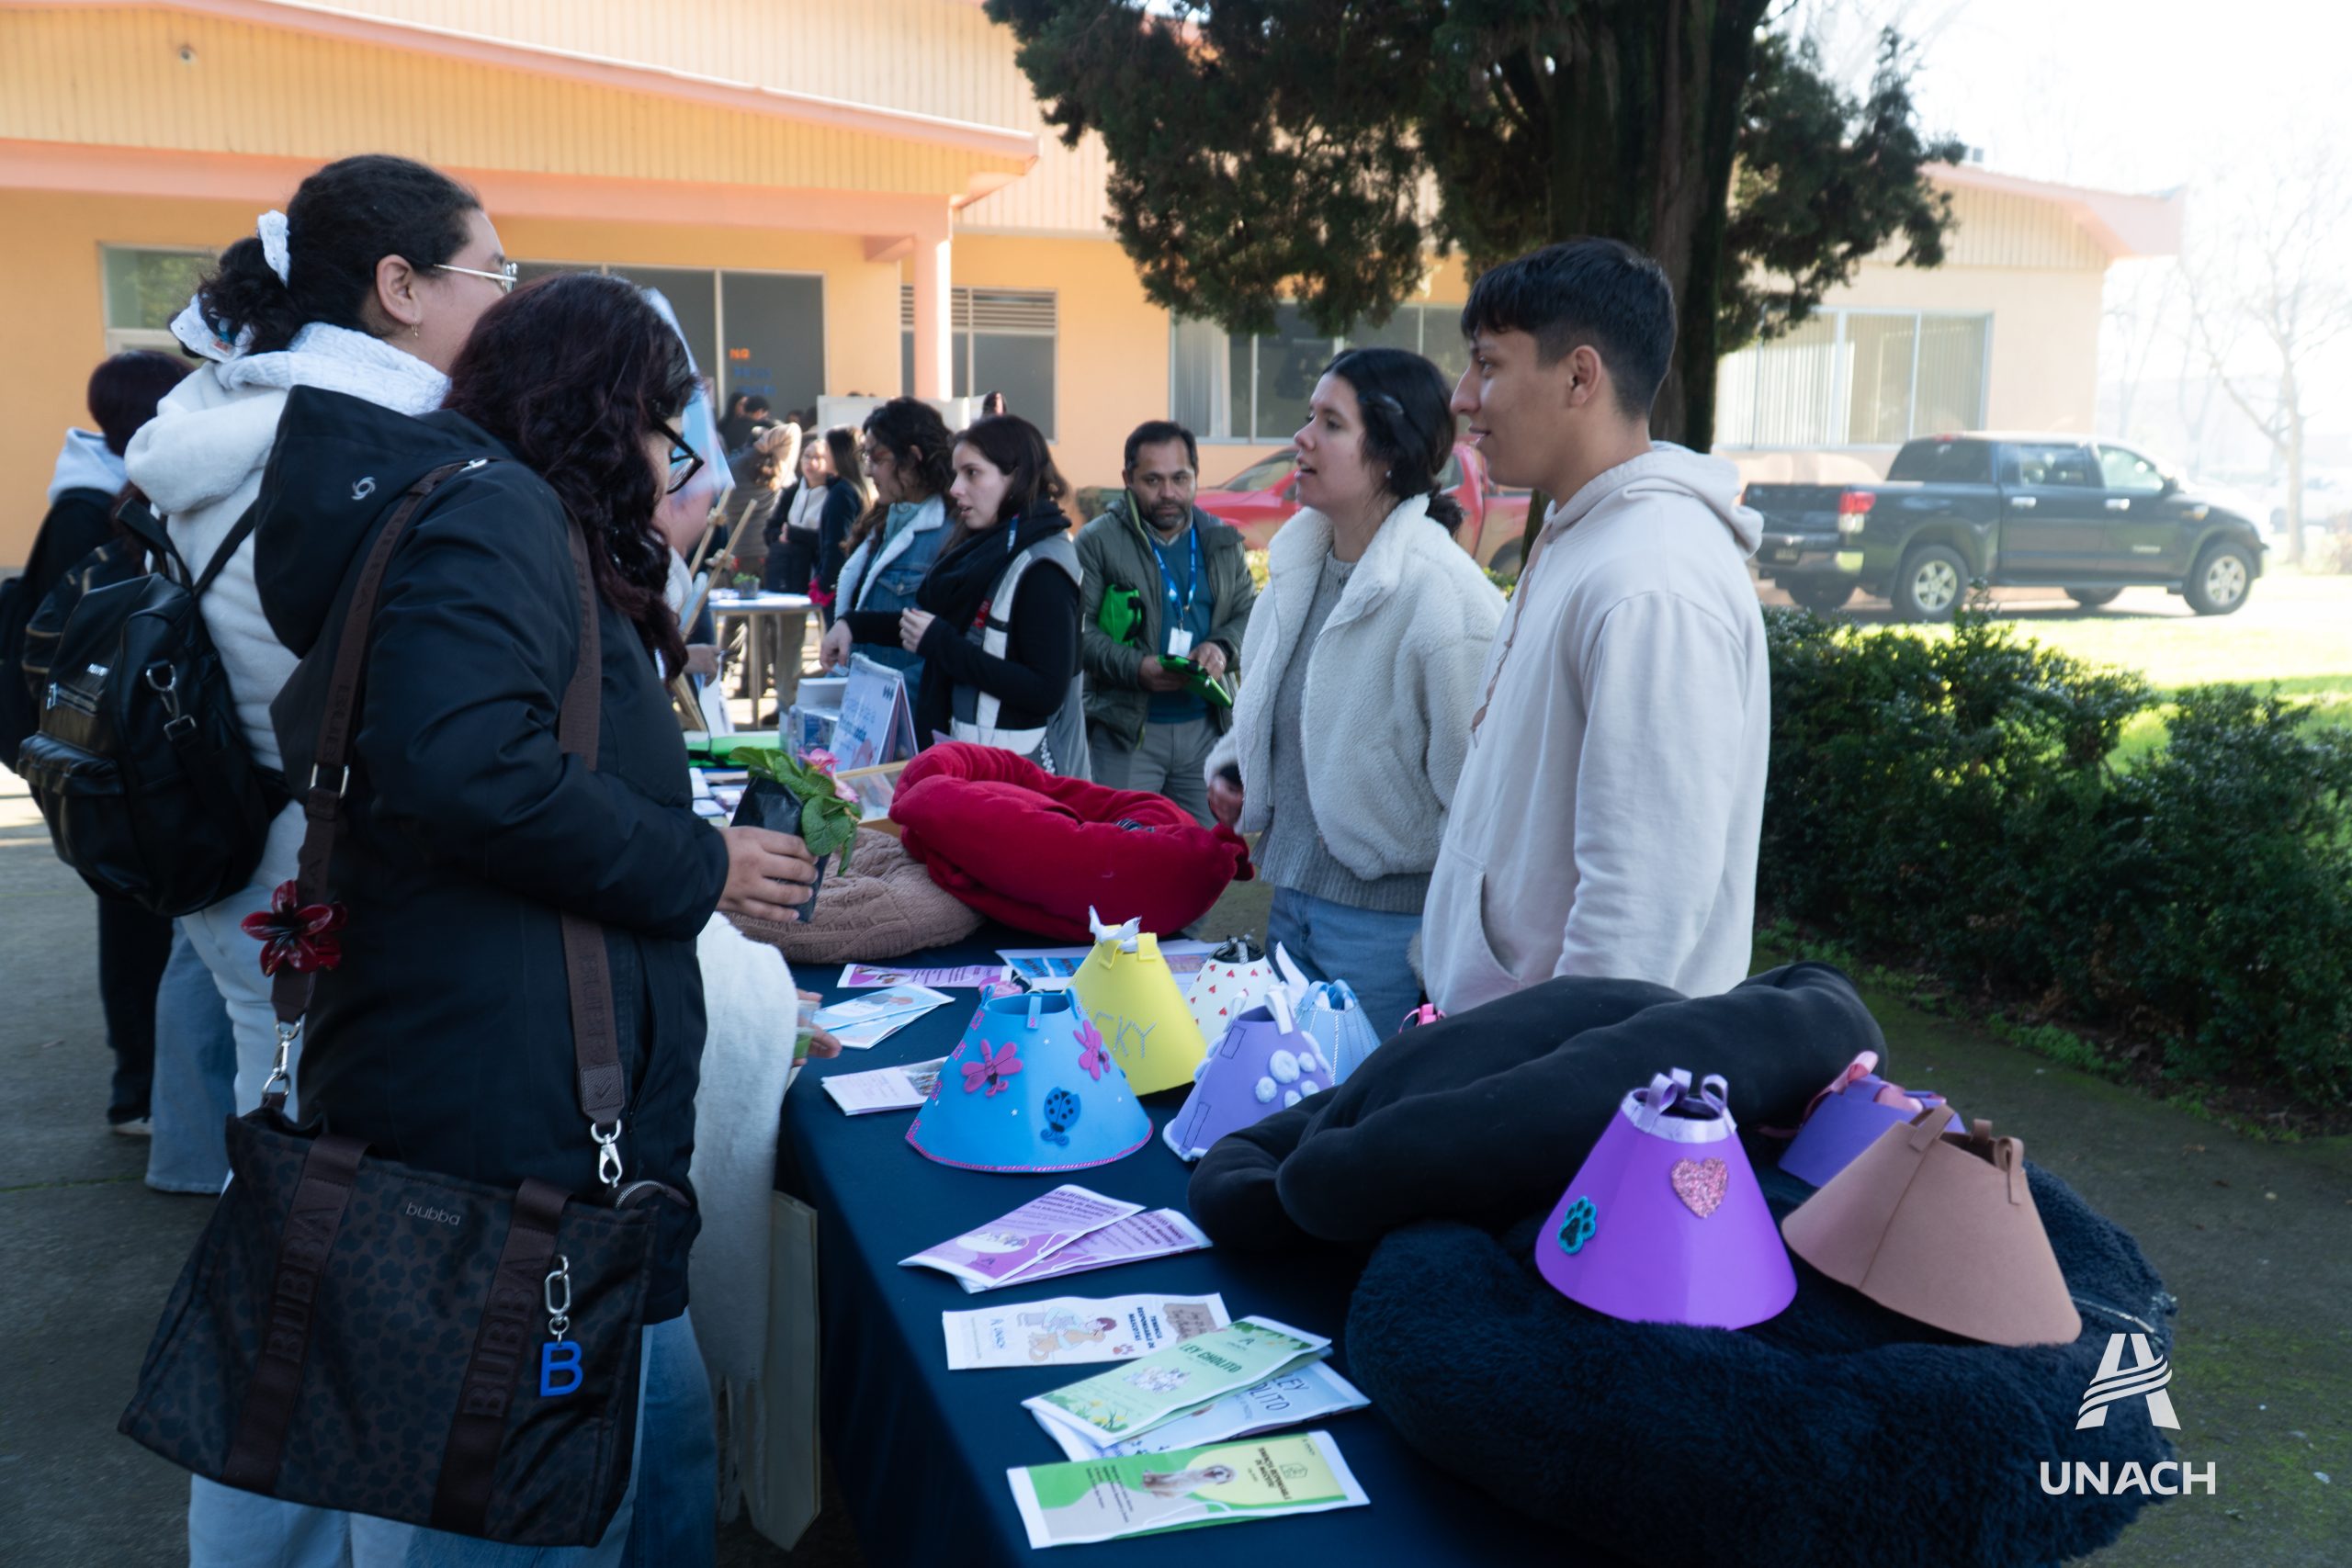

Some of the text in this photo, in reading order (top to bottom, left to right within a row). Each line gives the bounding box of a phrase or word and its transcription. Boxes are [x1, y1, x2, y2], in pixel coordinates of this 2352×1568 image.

[404, 1201, 461, 1227] bubba
[265, 1206, 342, 1365] BUBBA
[461, 1257, 546, 1419] BUBBA
[1179, 1343, 1204, 1354] LEY
[1197, 1351, 1243, 1373] CHOLITO
[540, 1341, 583, 1397] B
